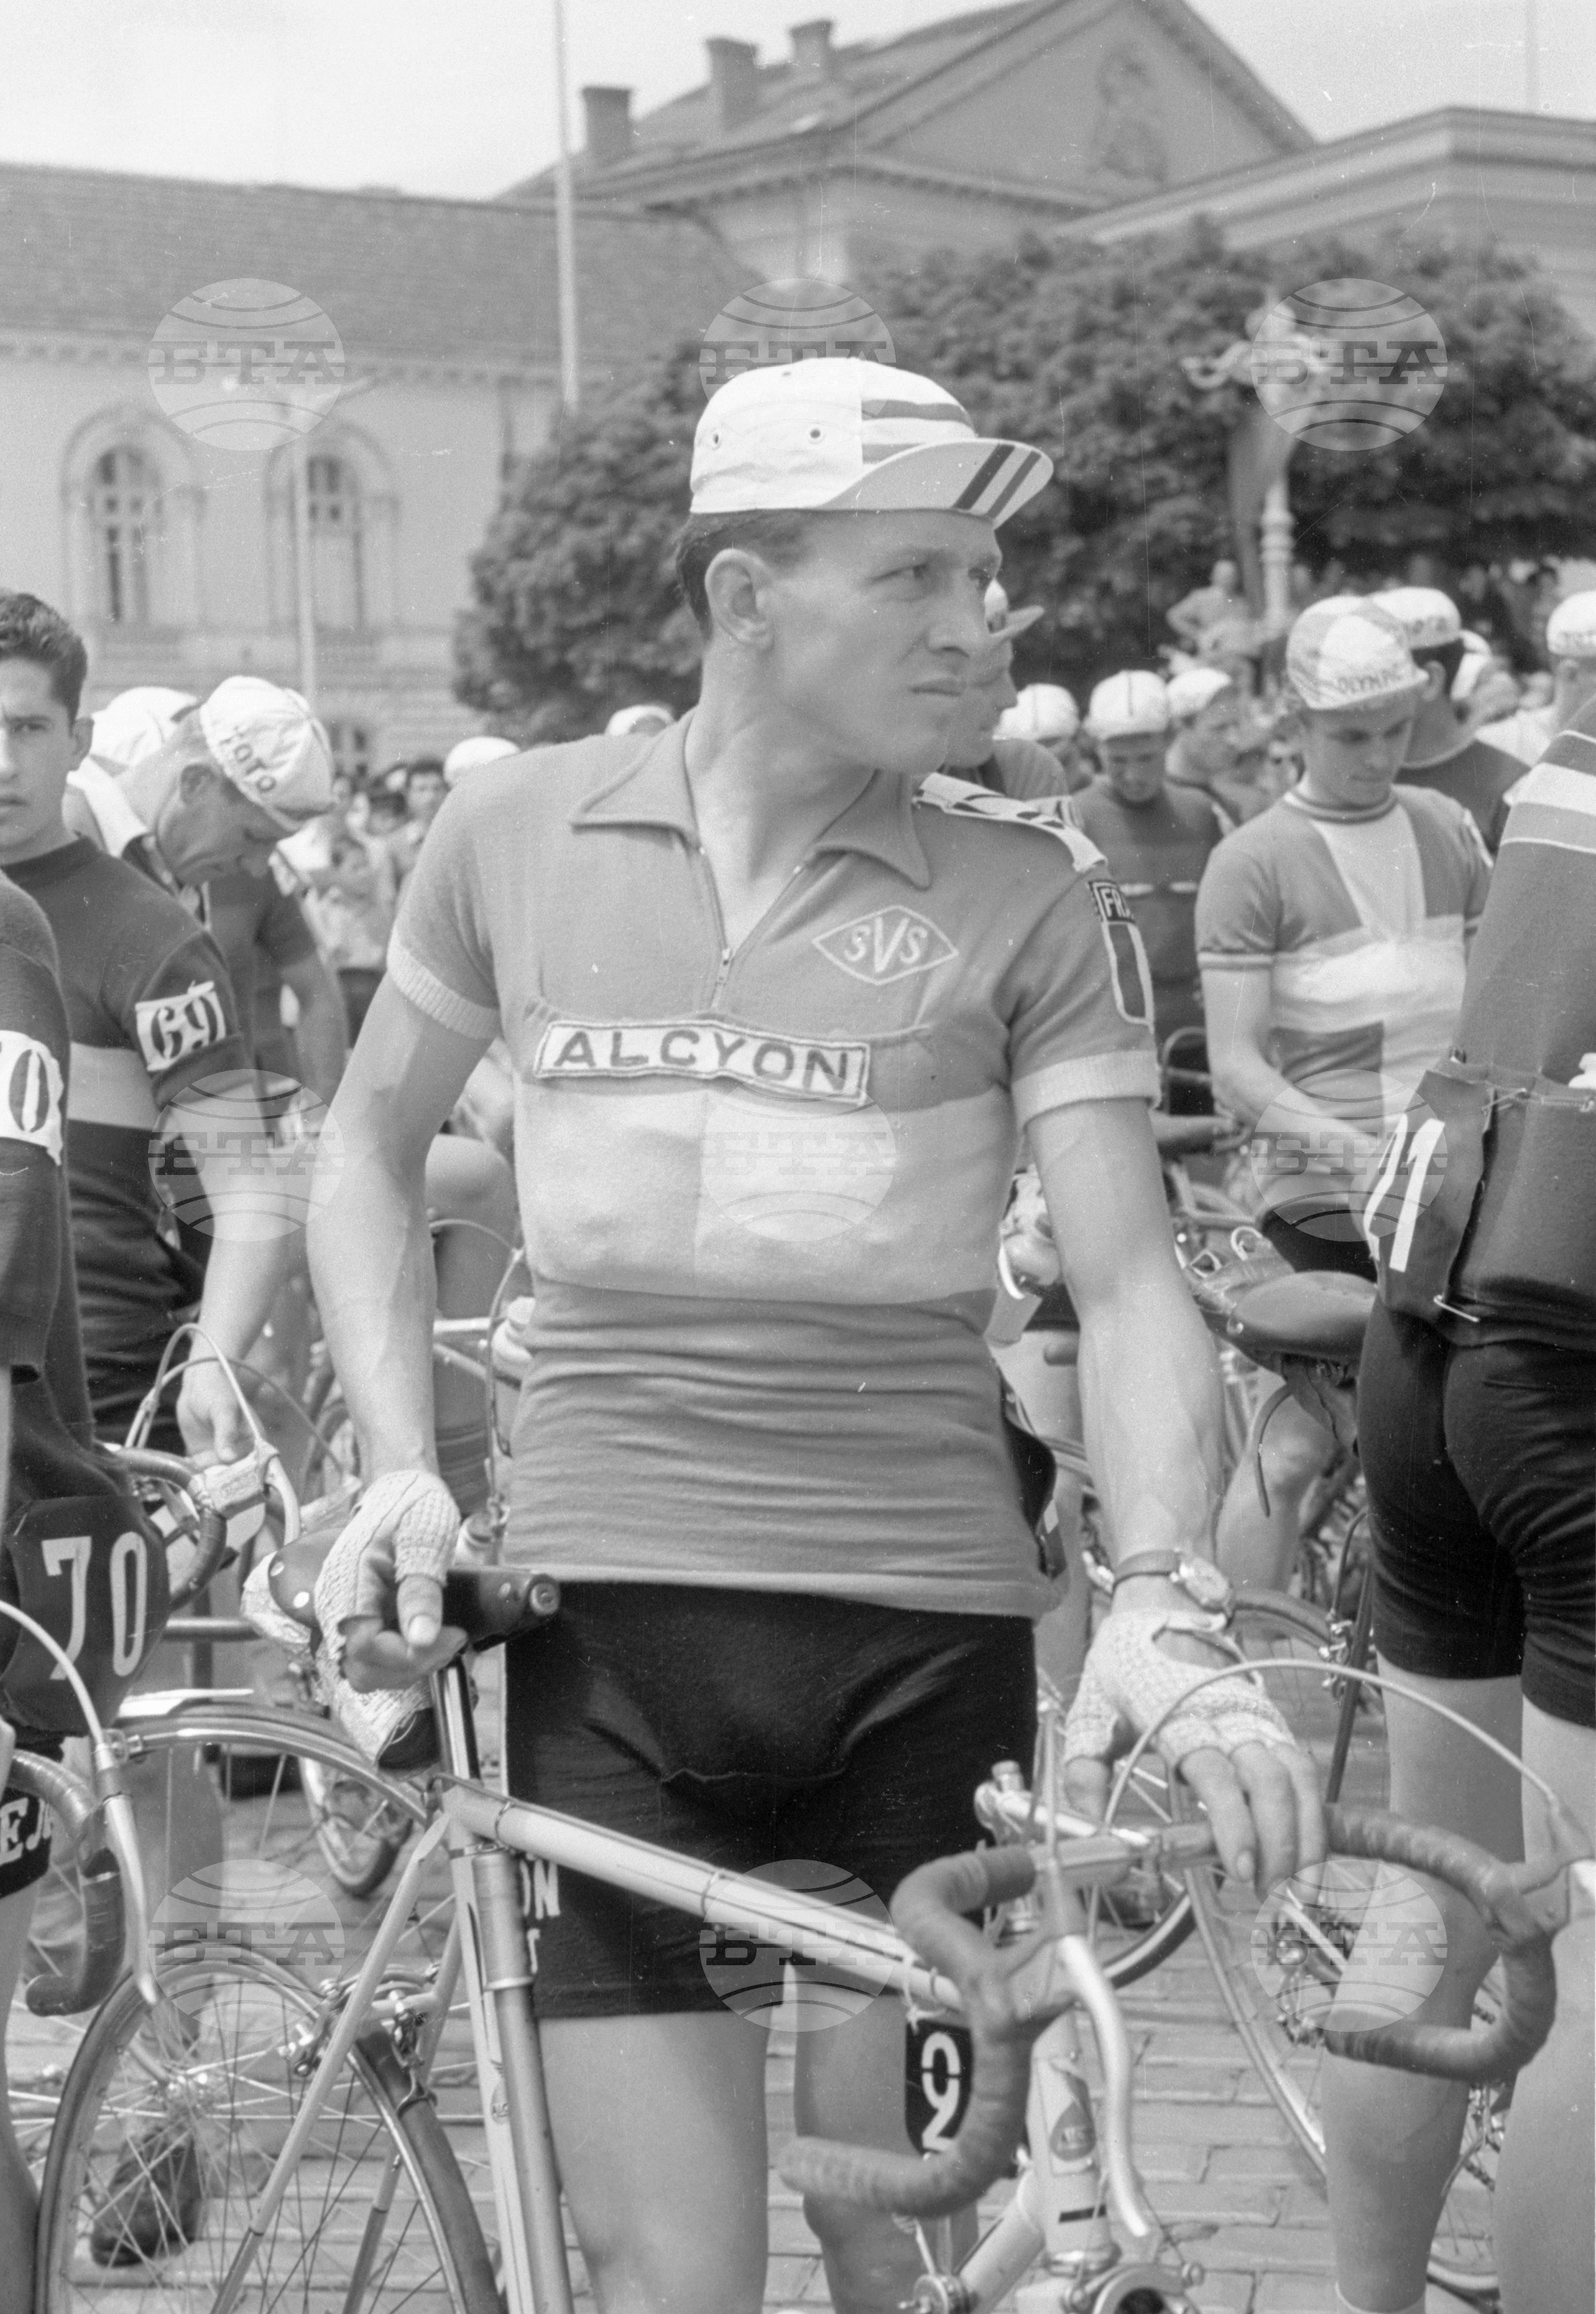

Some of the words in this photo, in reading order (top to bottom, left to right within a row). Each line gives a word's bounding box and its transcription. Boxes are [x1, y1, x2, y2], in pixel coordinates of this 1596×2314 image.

[1100, 888, 1132, 918] FR
[843, 916, 928, 973] SVS
[150, 995, 218, 1060] 69
[0, 1043, 50, 1133] 0
[554, 1030, 848, 1092] ALCYON
[41, 1531, 148, 1681] 70
